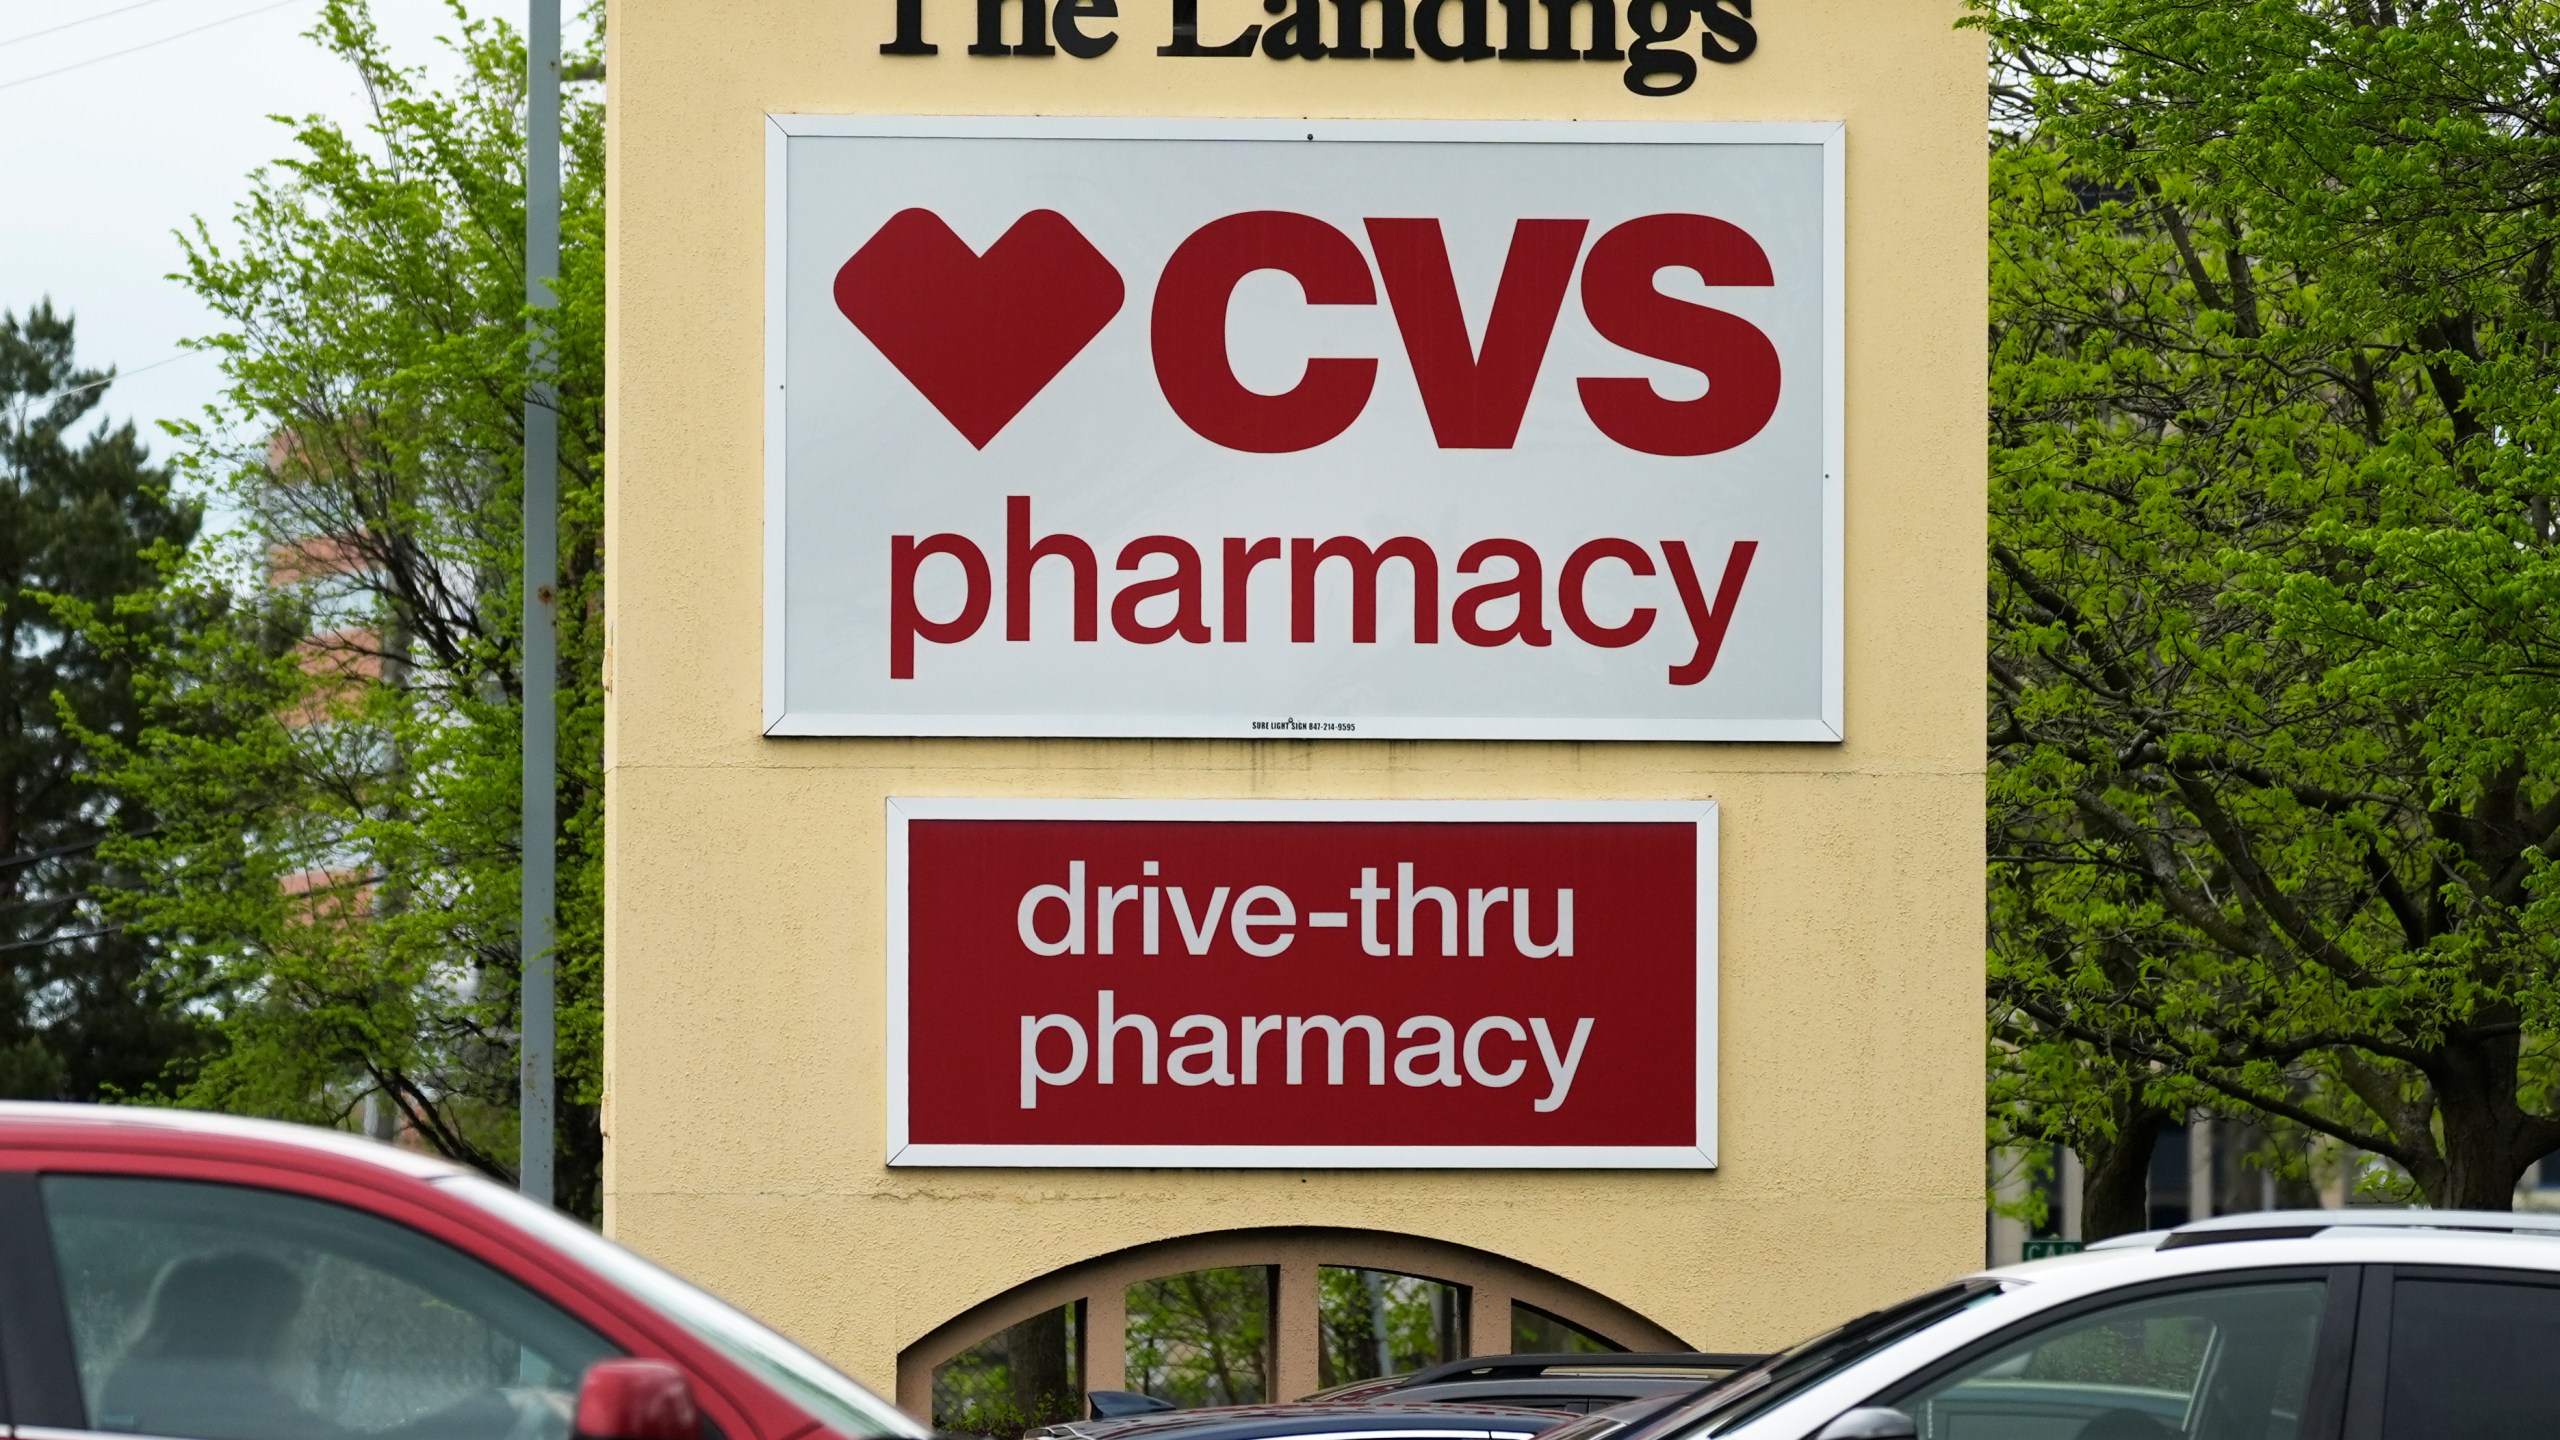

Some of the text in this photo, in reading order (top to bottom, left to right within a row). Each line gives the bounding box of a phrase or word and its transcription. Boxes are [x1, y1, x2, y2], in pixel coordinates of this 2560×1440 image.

[1157, 0, 1758, 97] Landings
[1151, 210, 1781, 457] CVS
[891, 495, 1758, 685] pharmacy
[1252, 721, 1356, 731] SURE LIGHT SIGN 847-214-9595
[1017, 860, 1574, 959] drive-thru
[1020, 989, 1595, 1113] pharmacy
